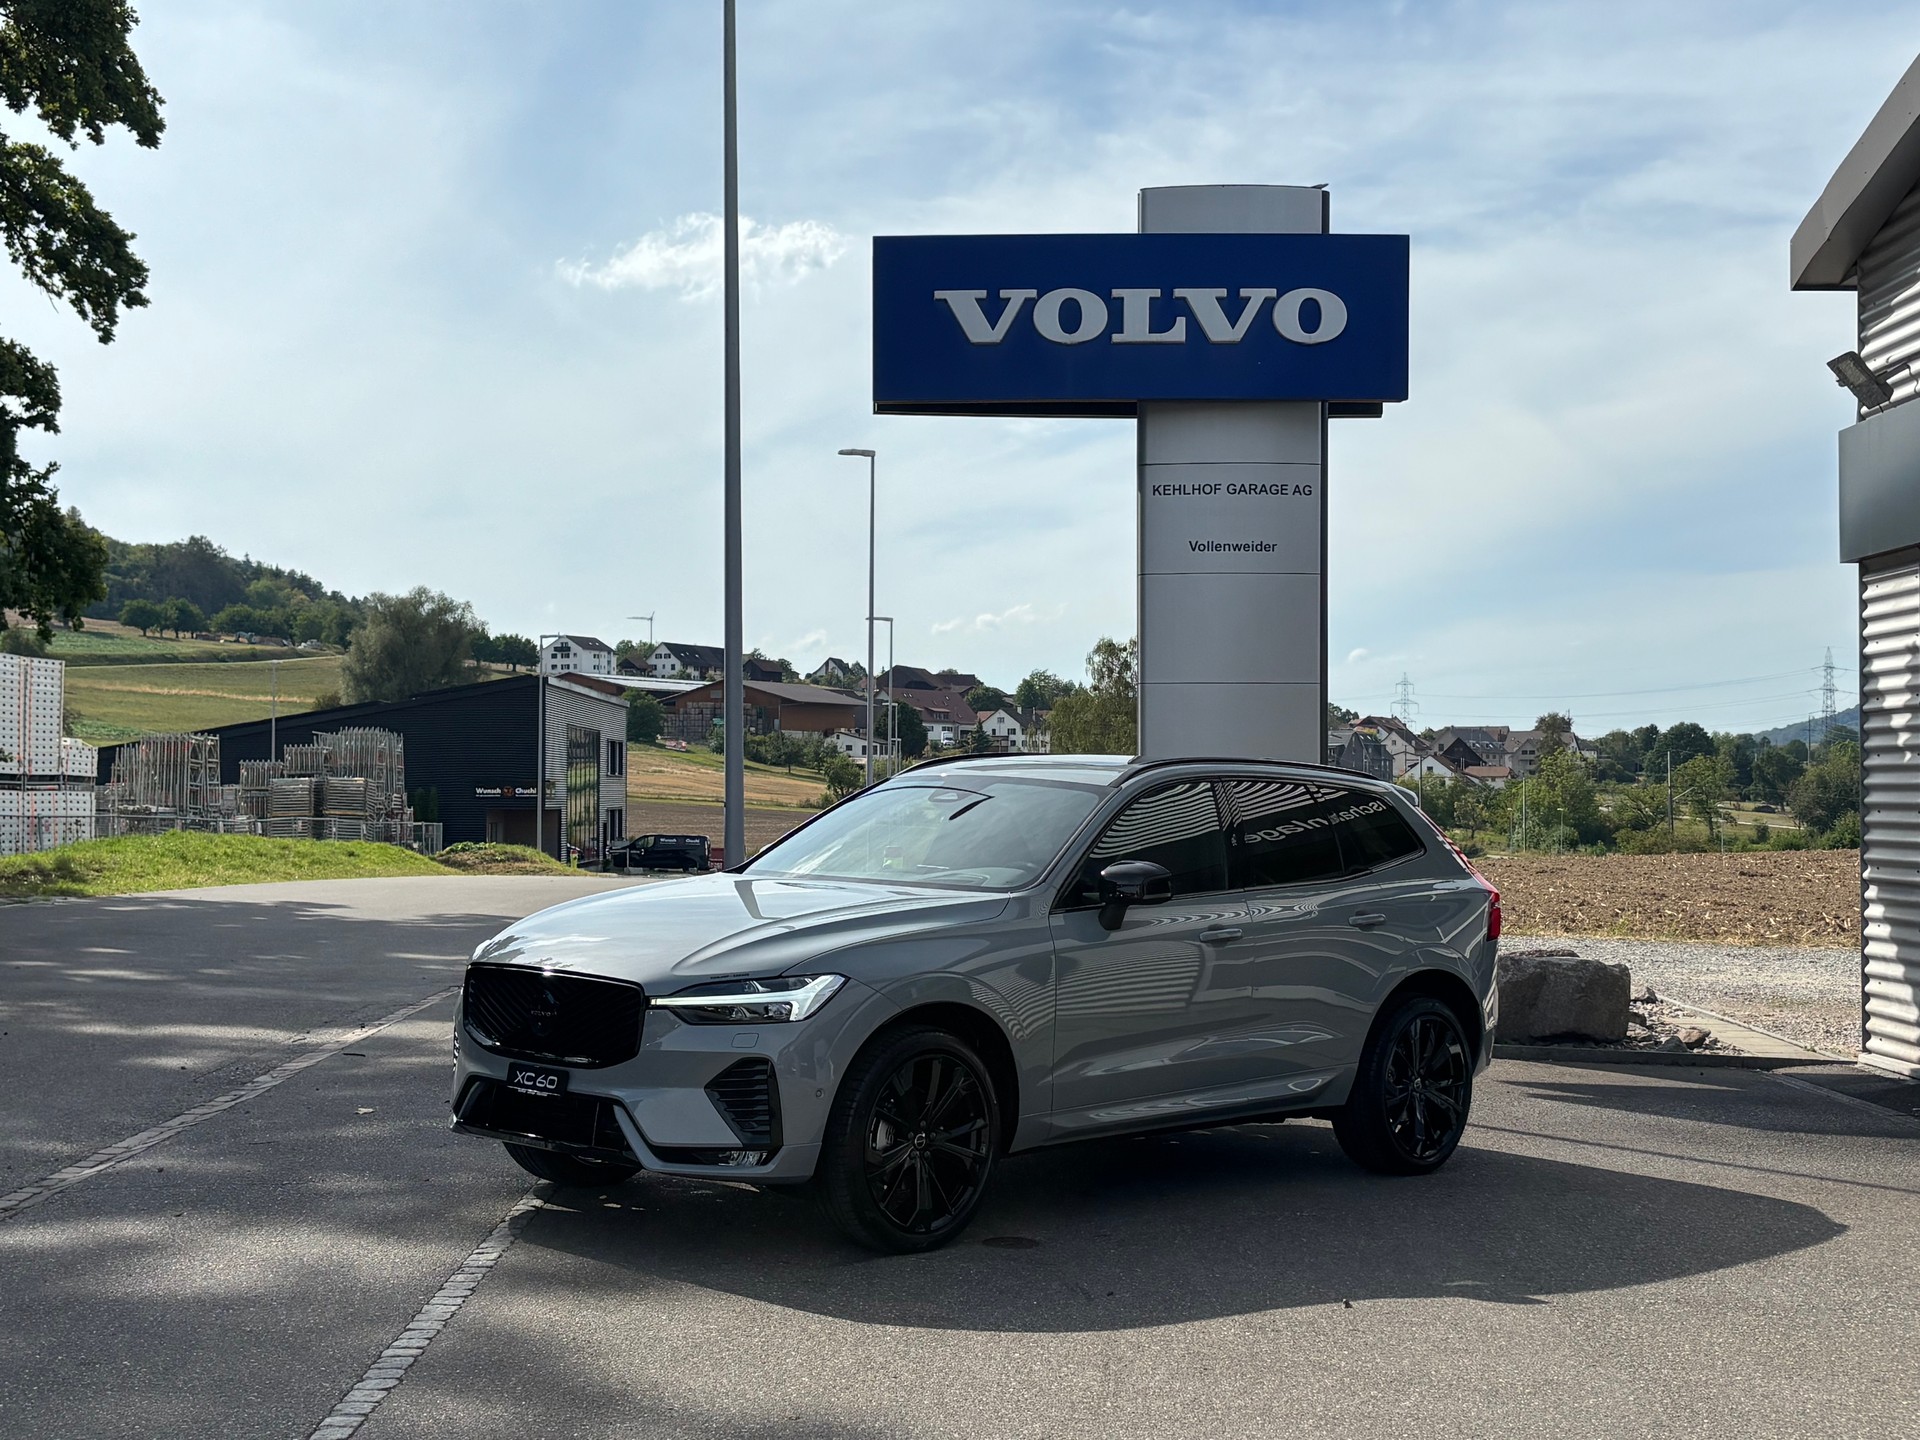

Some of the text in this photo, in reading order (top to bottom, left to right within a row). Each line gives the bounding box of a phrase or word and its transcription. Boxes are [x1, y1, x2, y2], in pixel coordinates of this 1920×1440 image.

[933, 287, 1349, 345] VOLVO
[1152, 483, 1313, 496] KEHLHOF GARAGE AG
[1188, 540, 1278, 553] Vollenweider
[513, 1070, 558, 1090] XC60
